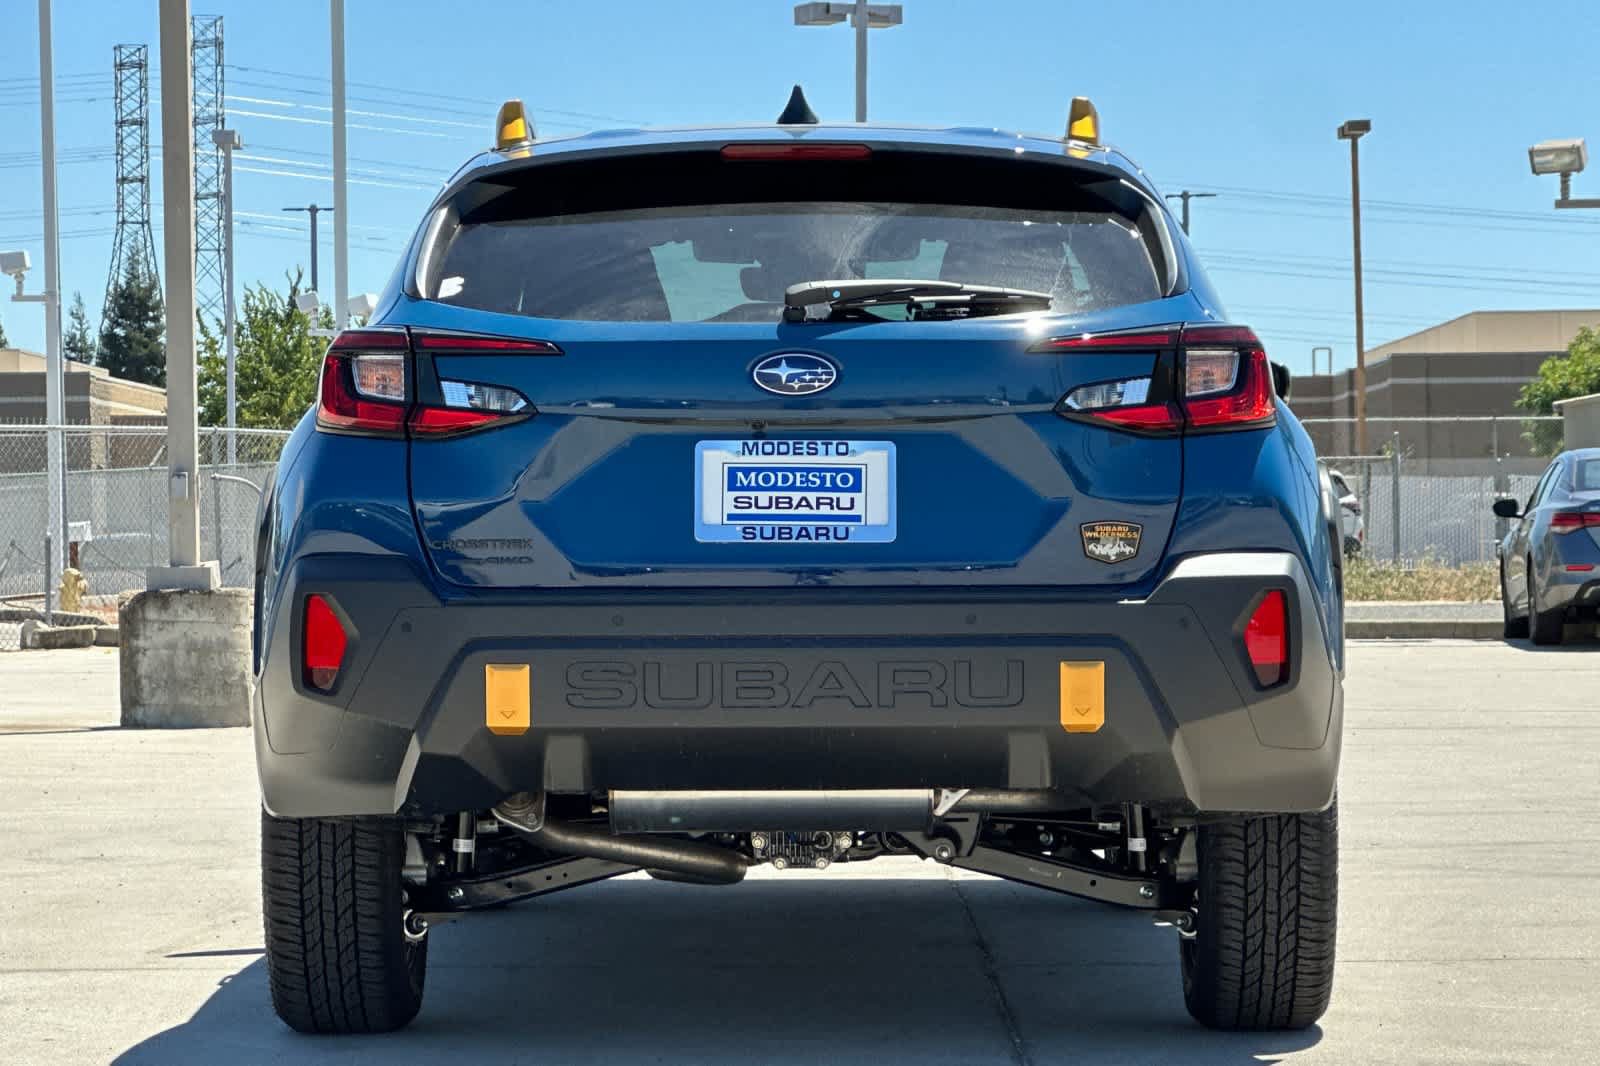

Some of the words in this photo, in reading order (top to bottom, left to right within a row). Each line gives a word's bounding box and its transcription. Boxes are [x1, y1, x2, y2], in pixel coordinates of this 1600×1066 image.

[741, 441, 850, 456] MODESTO
[735, 471, 854, 488] MODESTO
[733, 496, 855, 511] SUBARU
[742, 526, 849, 541] SUBARU
[565, 659, 1025, 709] SUBARU
